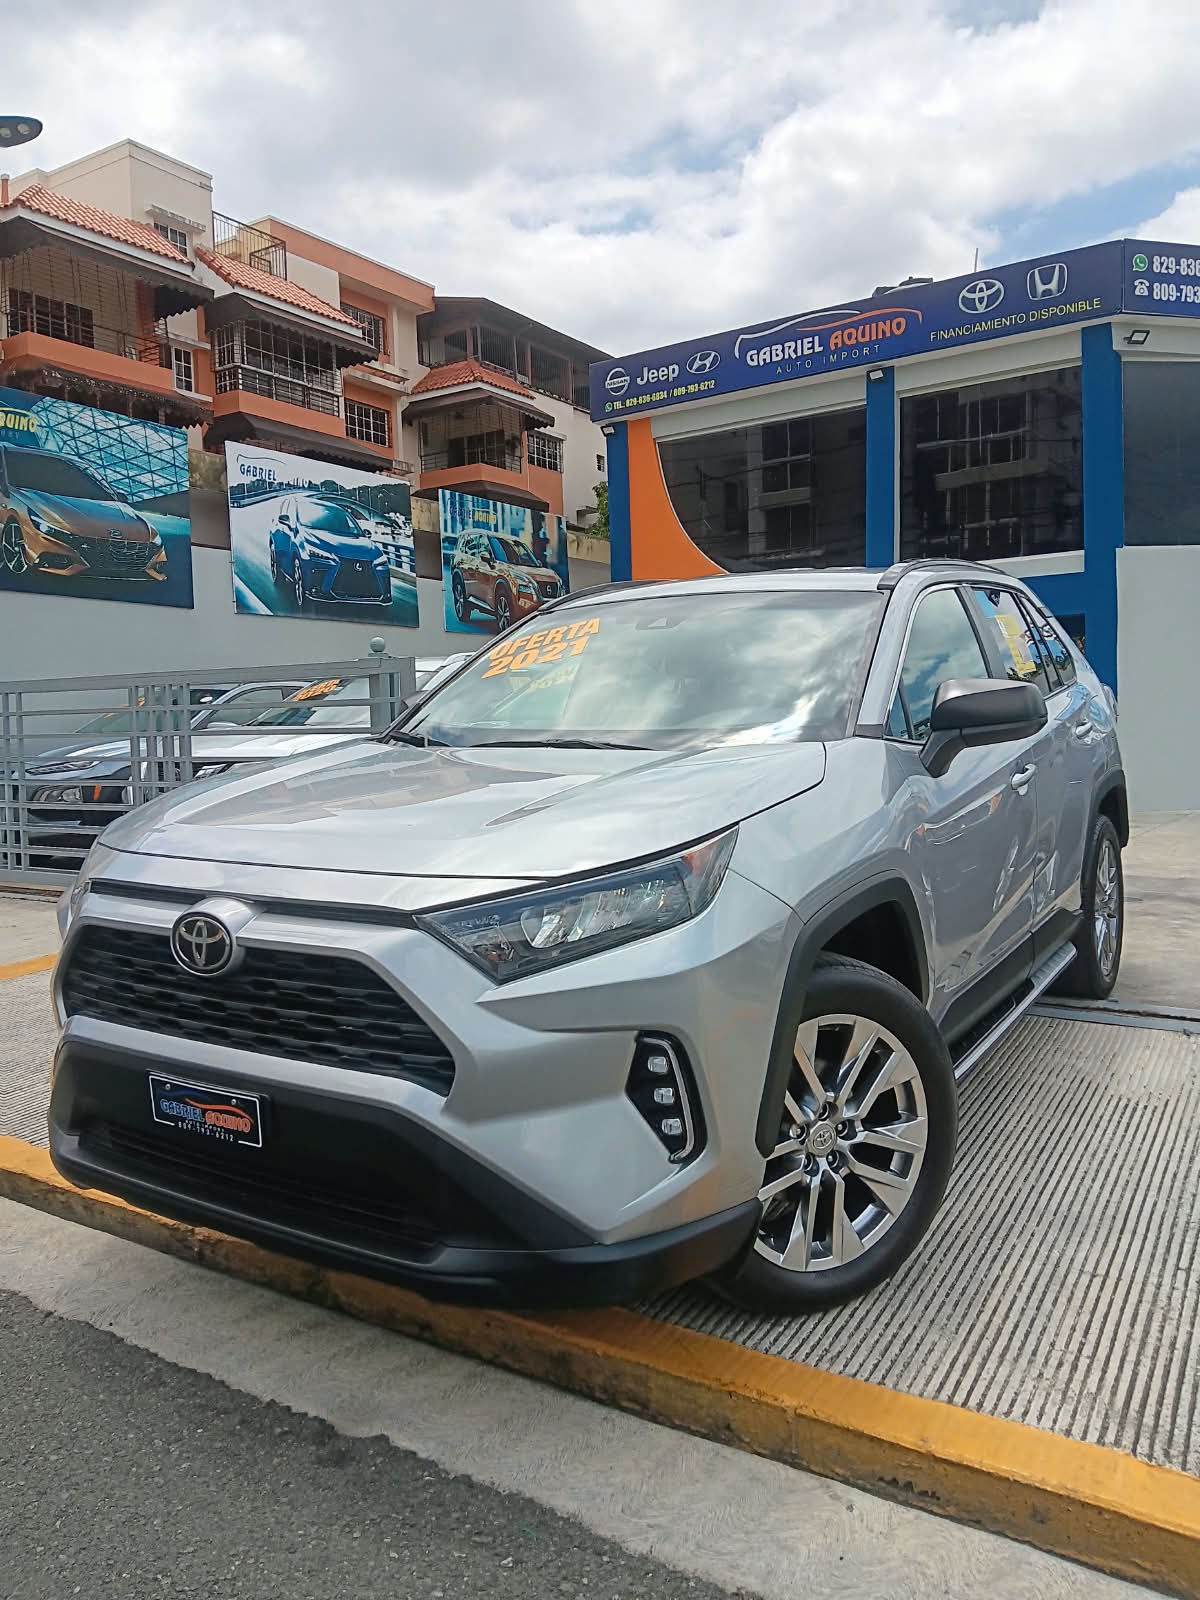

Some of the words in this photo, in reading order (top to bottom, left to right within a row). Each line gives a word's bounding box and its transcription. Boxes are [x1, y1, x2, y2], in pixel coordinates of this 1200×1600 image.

[930, 313, 1026, 343] FINANCIAMIENTO
[1029, 297, 1102, 322] DISPONIBLE
[746, 335, 824, 367] GABRIEL
[829, 317, 906, 351] AQUINO
[776, 359, 813, 375] AUTO
[823, 345, 880, 366] IMPORT
[606, 378, 629, 388] NISSAN
[636, 364, 679, 385] Jeep
[239, 463, 277, 482] GABRIEL
[489, 617, 601, 660] OFERTA
[481, 636, 590, 680] 2021
